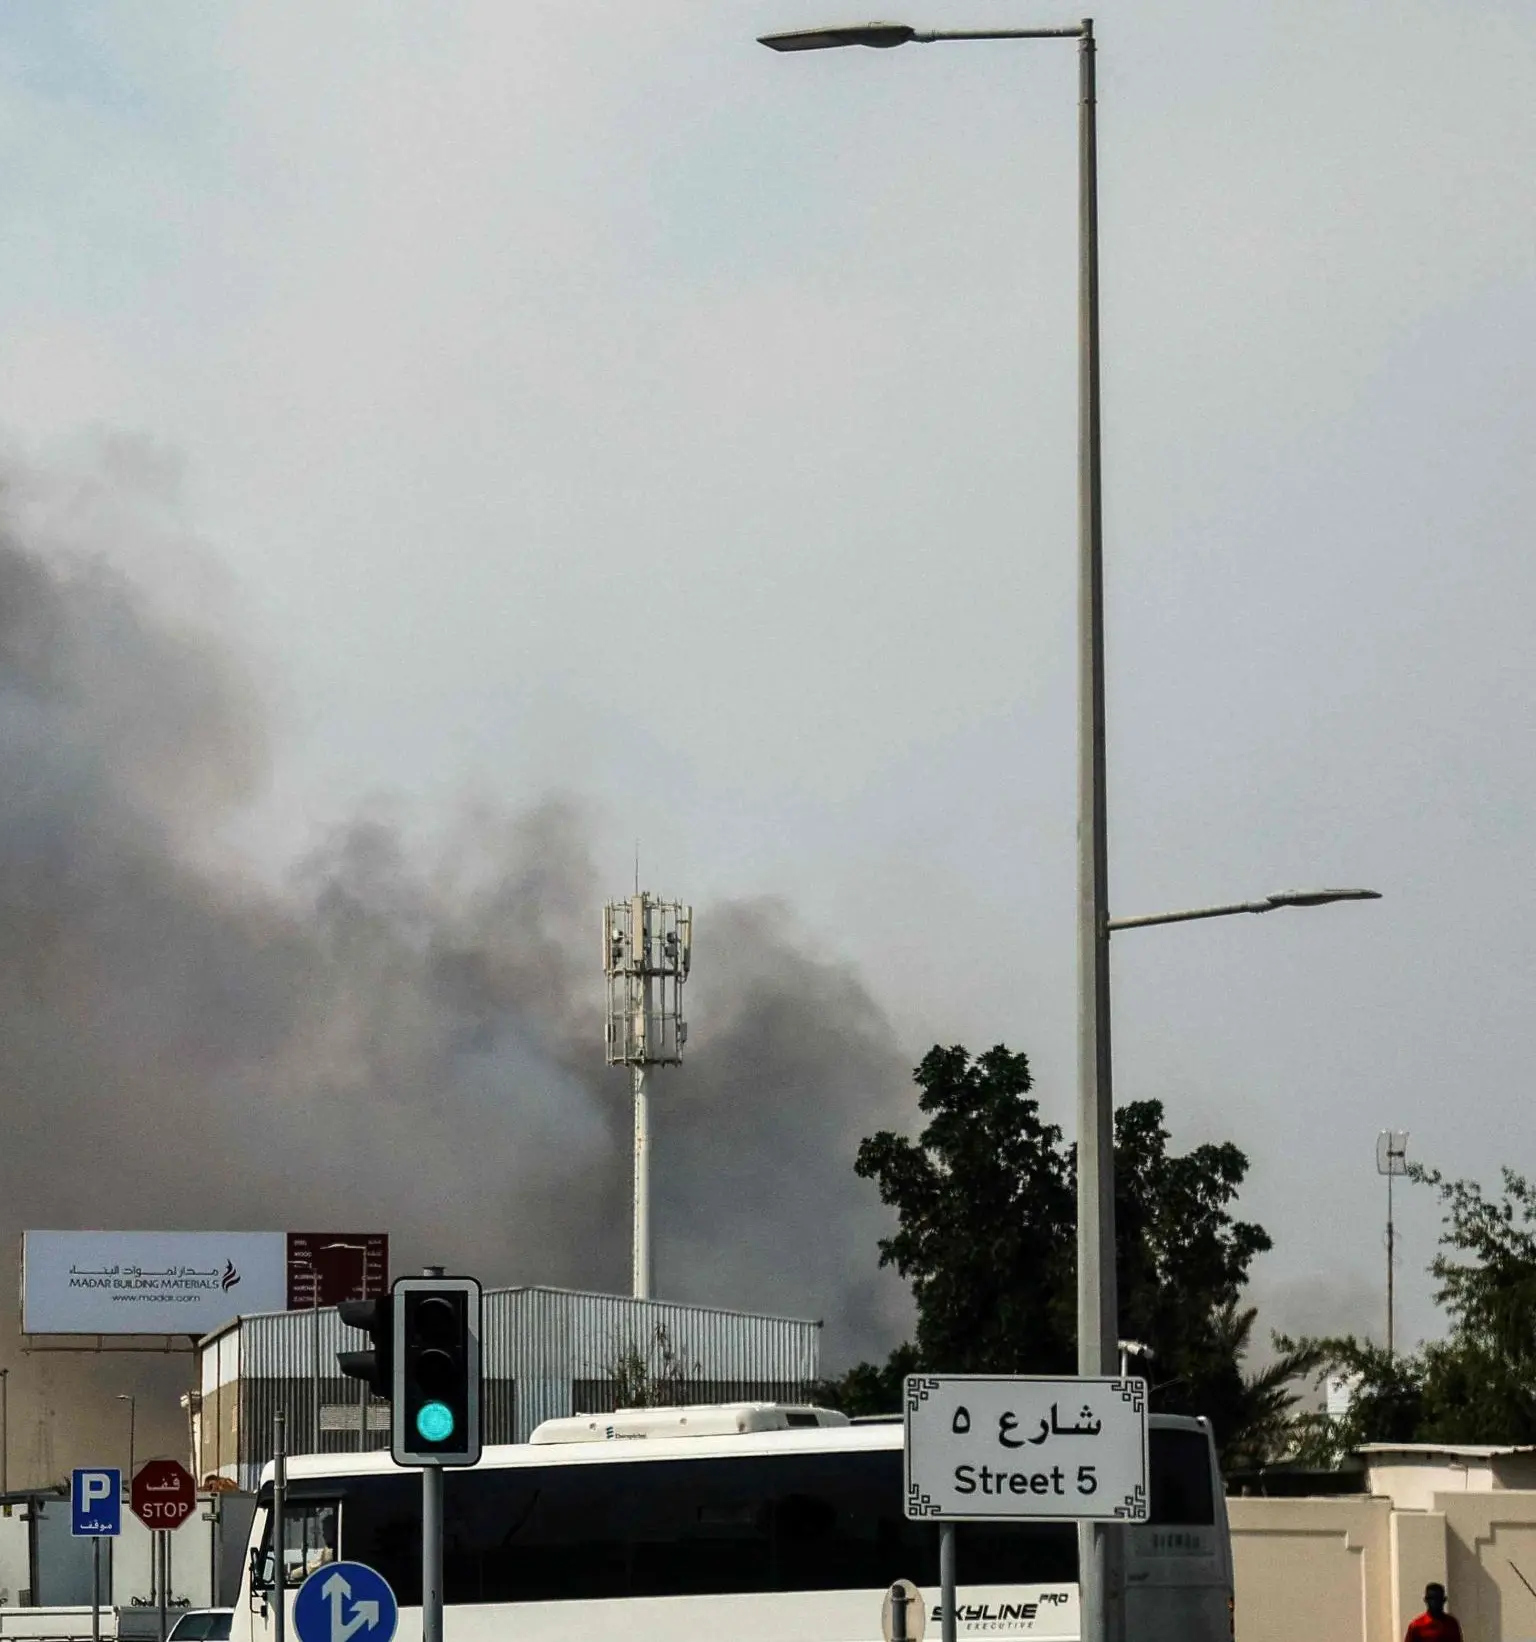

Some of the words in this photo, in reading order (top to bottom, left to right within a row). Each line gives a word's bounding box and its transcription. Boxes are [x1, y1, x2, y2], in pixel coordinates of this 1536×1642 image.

[69, 1279, 111, 1289] MADAR
[114, 1279, 159, 1289] BUILDING
[161, 1279, 219, 1289] MATERIALS
[112, 1294, 200, 1302] www.madar.com
[951, 1405, 971, 1435] ٥
[998, 1402, 1103, 1449] شارع
[146, 1472, 181, 1491] قف
[954, 1465, 1065, 1495] Street
[1076, 1466, 1098, 1495] 5
[81, 1473, 111, 1513] P
[143, 1502, 189, 1518] STOP
[80, 1519, 113, 1531] موقف
[1039, 1593, 1068, 1606] PRO
[967, 1622, 1034, 1631] EXECUTIVE
